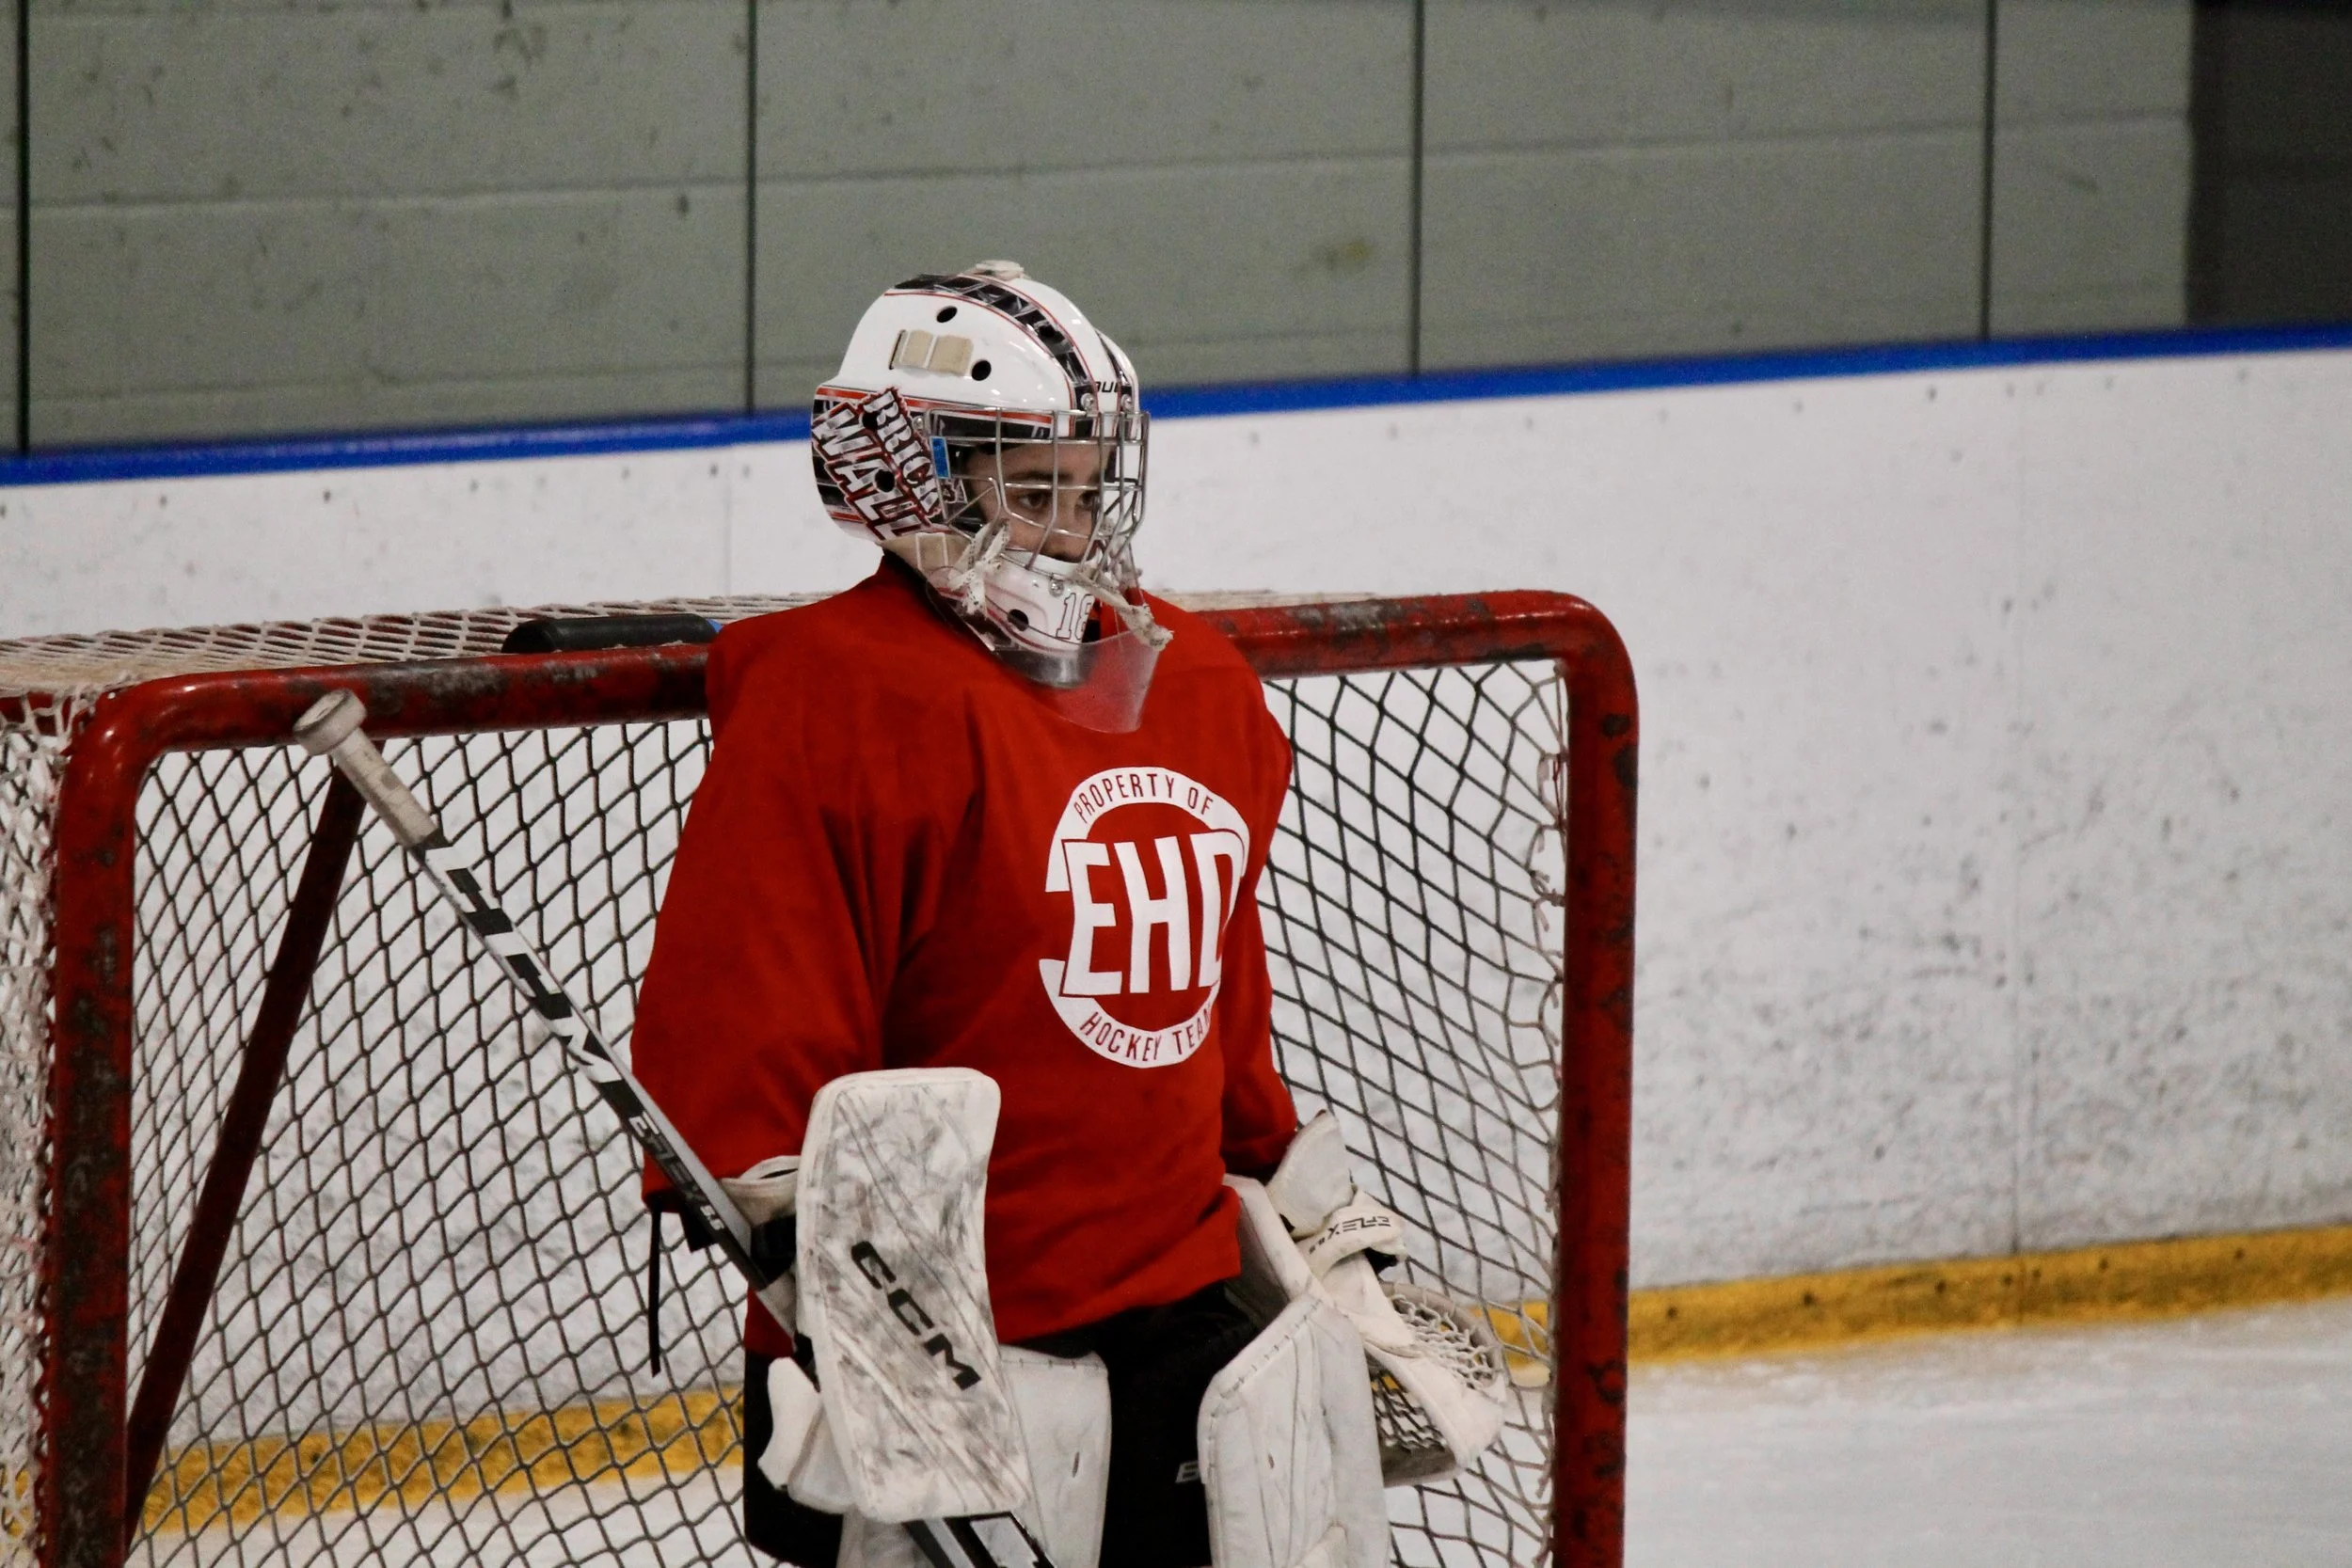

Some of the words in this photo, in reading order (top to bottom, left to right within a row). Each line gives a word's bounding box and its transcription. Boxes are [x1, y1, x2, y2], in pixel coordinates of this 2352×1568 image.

[811, 408, 923, 540] WALL
[863, 389, 940, 514] BRICK
[1073, 773, 1174, 824] PROPERTY
[1187, 786, 1214, 815] OF
[1063, 831, 1245, 995] EHD
[1080, 1011, 1161, 1062] HOCKEY
[850, 1241, 981, 1391] CCM
